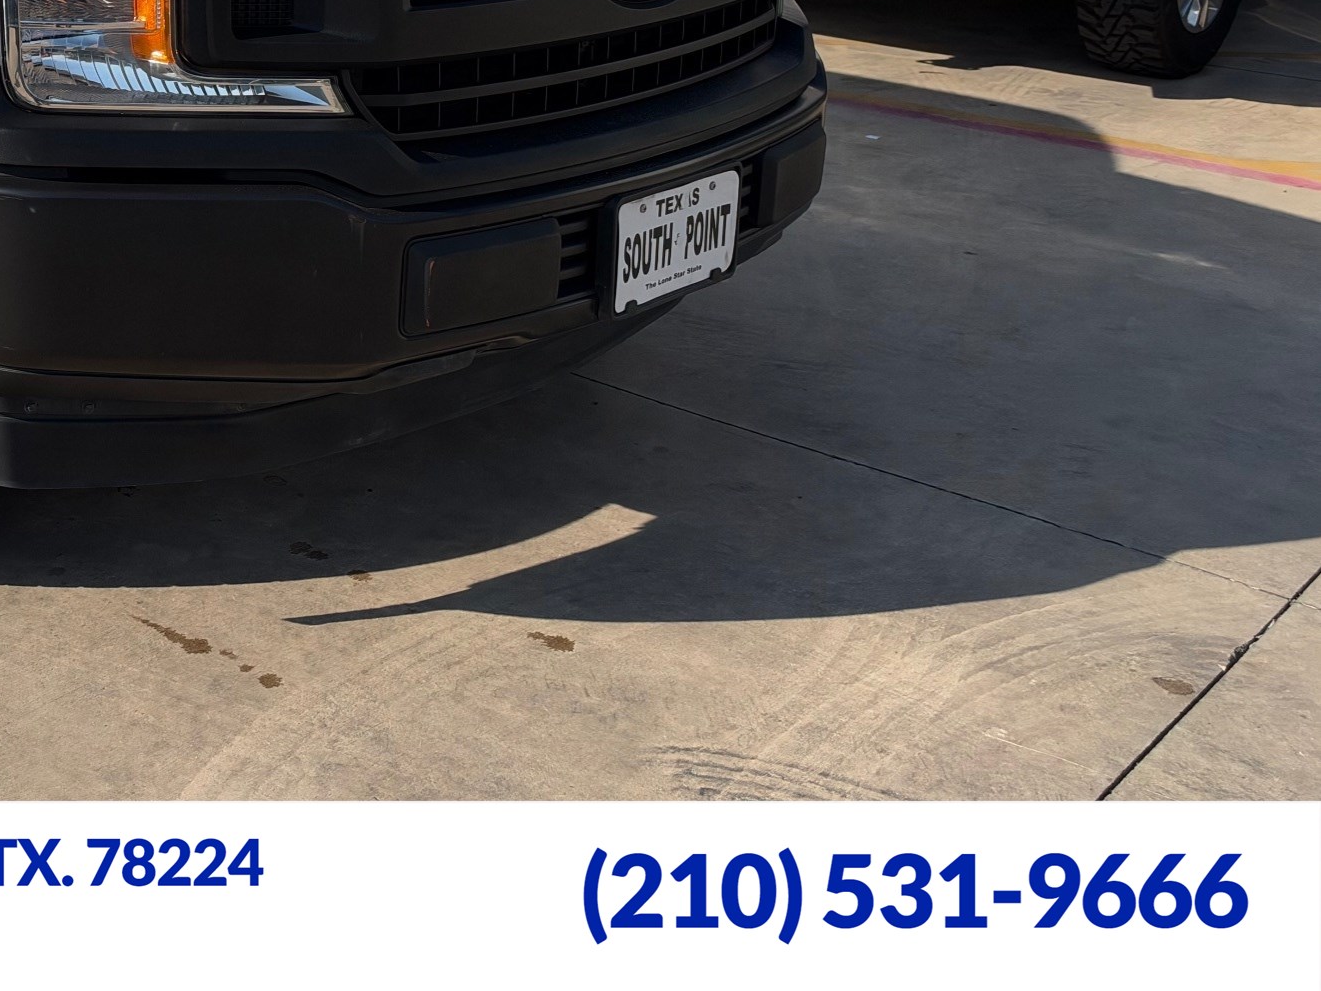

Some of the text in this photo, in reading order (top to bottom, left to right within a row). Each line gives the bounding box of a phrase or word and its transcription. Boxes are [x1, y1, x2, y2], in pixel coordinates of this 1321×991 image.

[623, 203, 731, 284] SOUTH POINT
[645, 282, 656, 291] The
[673, 269, 685, 280] Star
